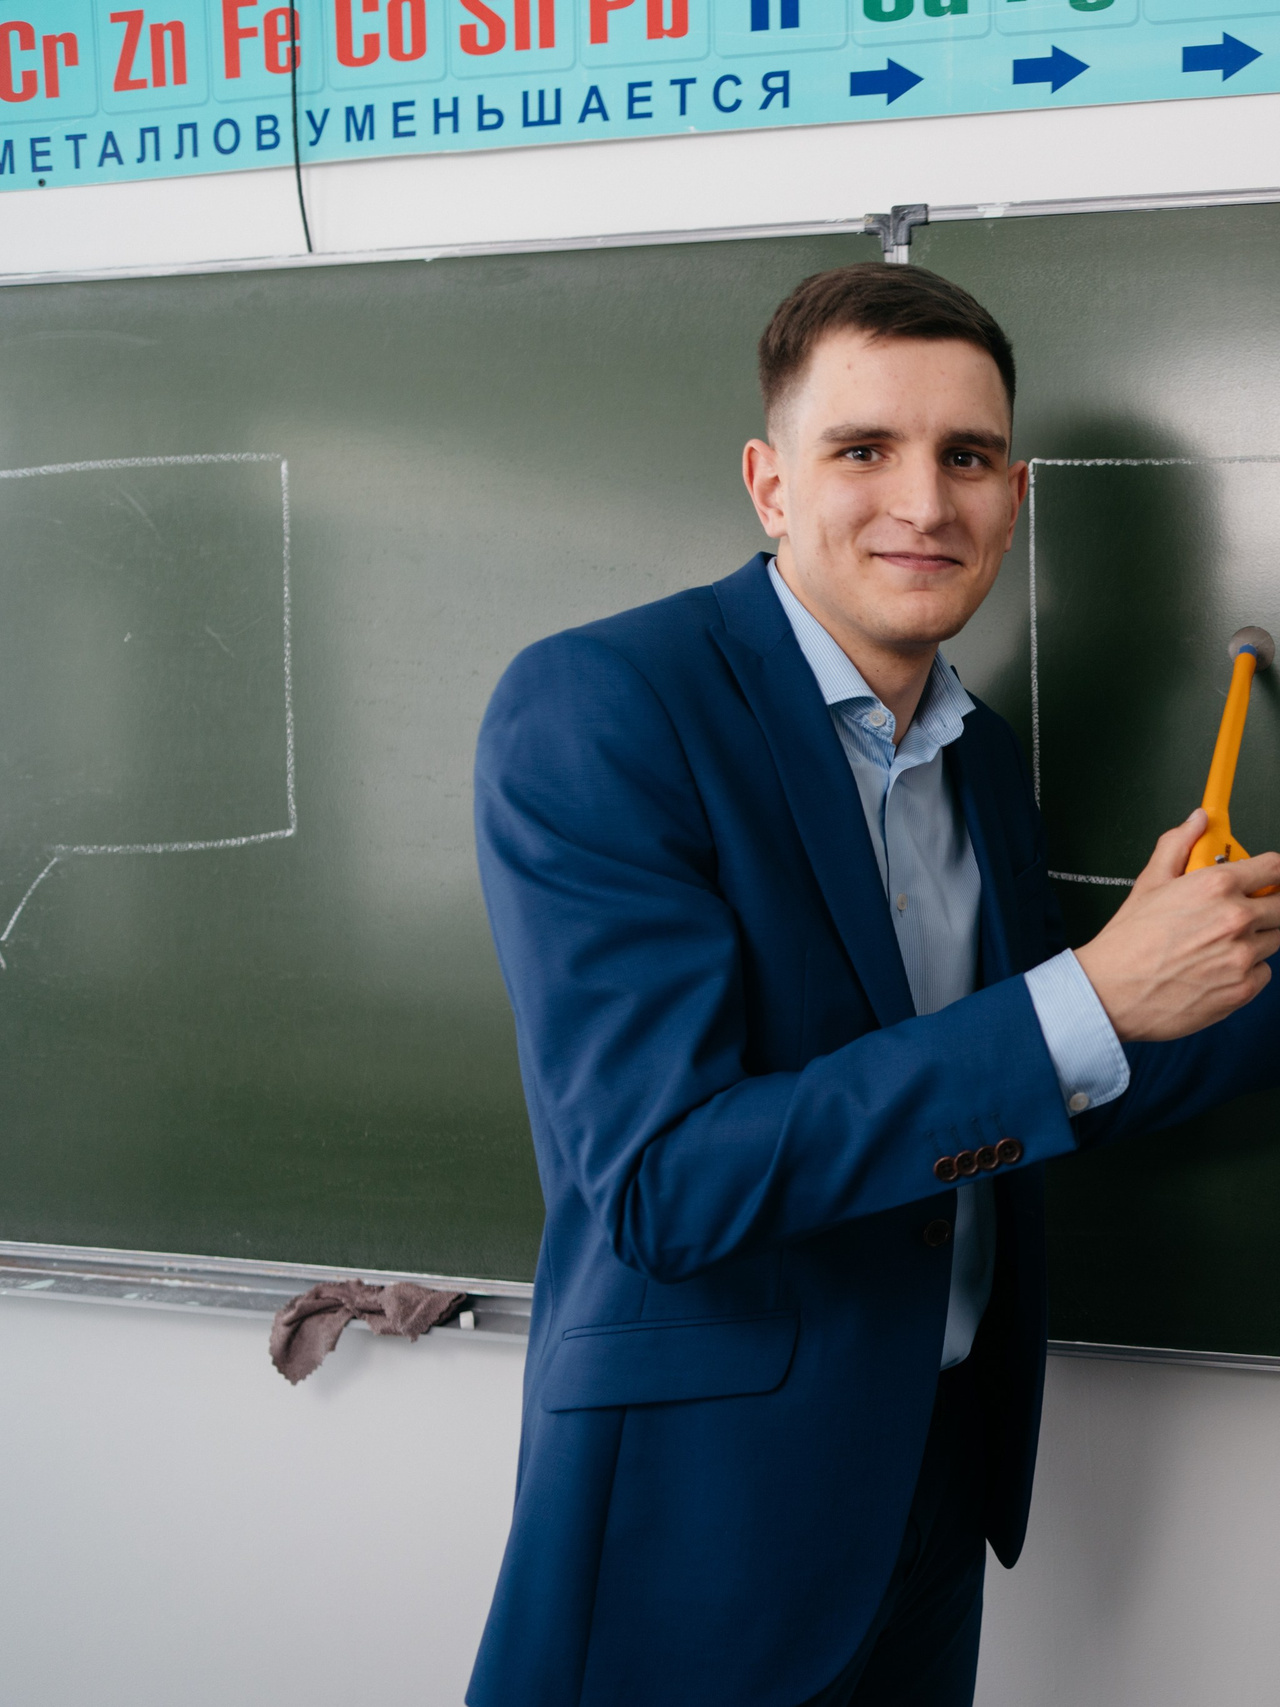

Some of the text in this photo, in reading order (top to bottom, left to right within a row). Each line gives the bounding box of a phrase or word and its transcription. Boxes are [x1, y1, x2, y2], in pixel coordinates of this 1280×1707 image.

[0, 20, 79, 103] Cr
[110, 9, 187, 92] Zn
[222, 0, 302, 79] Fe
[334, 0, 427, 68] Co
[305, 70, 790, 147] УМЕНЬШАЕТСЯ
